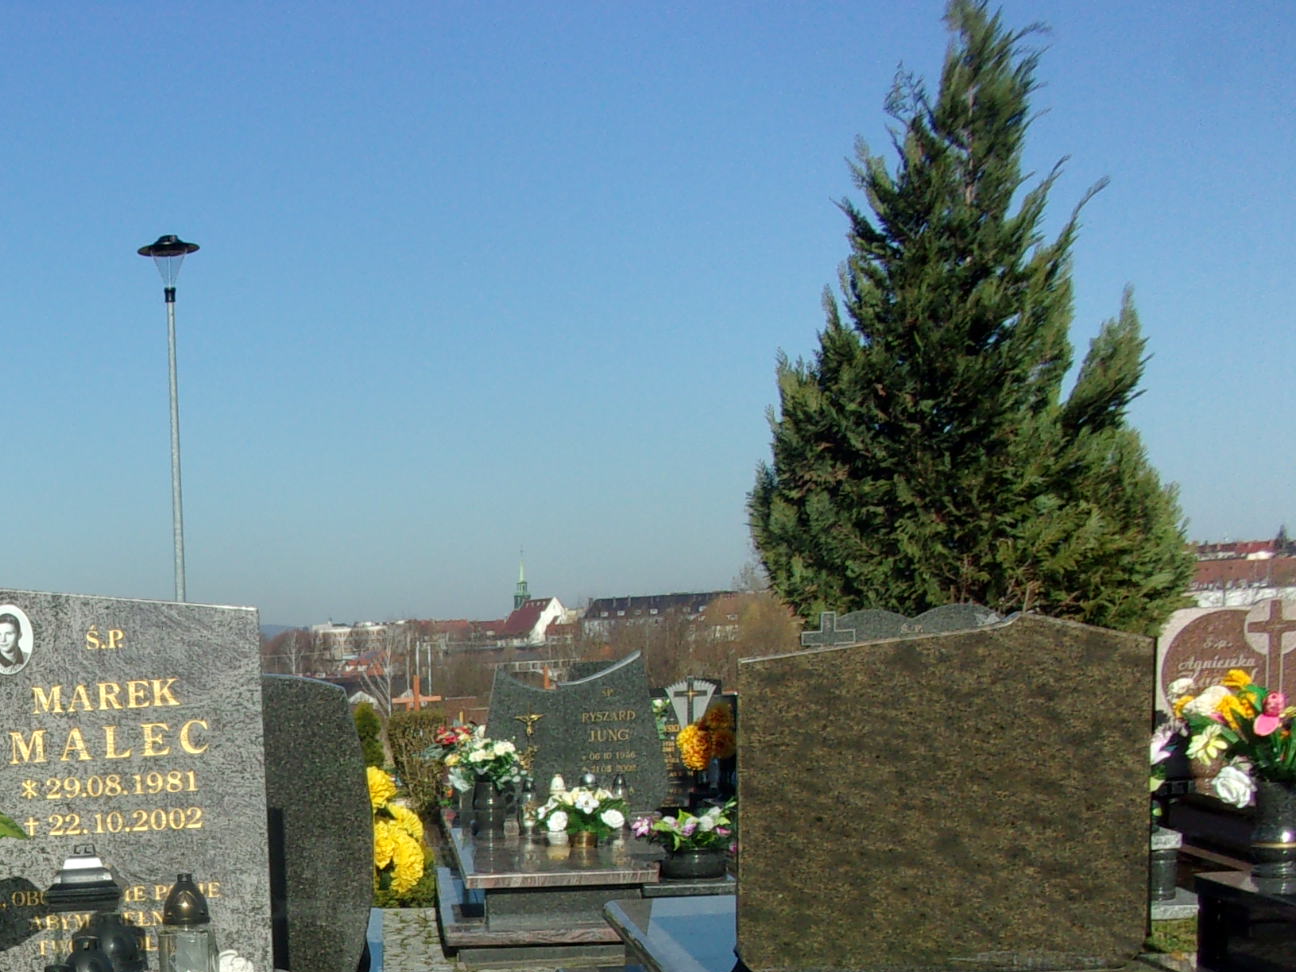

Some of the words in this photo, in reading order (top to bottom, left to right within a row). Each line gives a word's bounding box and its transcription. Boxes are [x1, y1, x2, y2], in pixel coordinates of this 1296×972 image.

[31, 677, 181, 715] MAREK
[581, 709, 637, 723] RYSZARD
[8, 719, 210, 765] MALEC
[588, 727, 630, 742] JUNG
[48, 806, 203, 837] 22.10.2002
